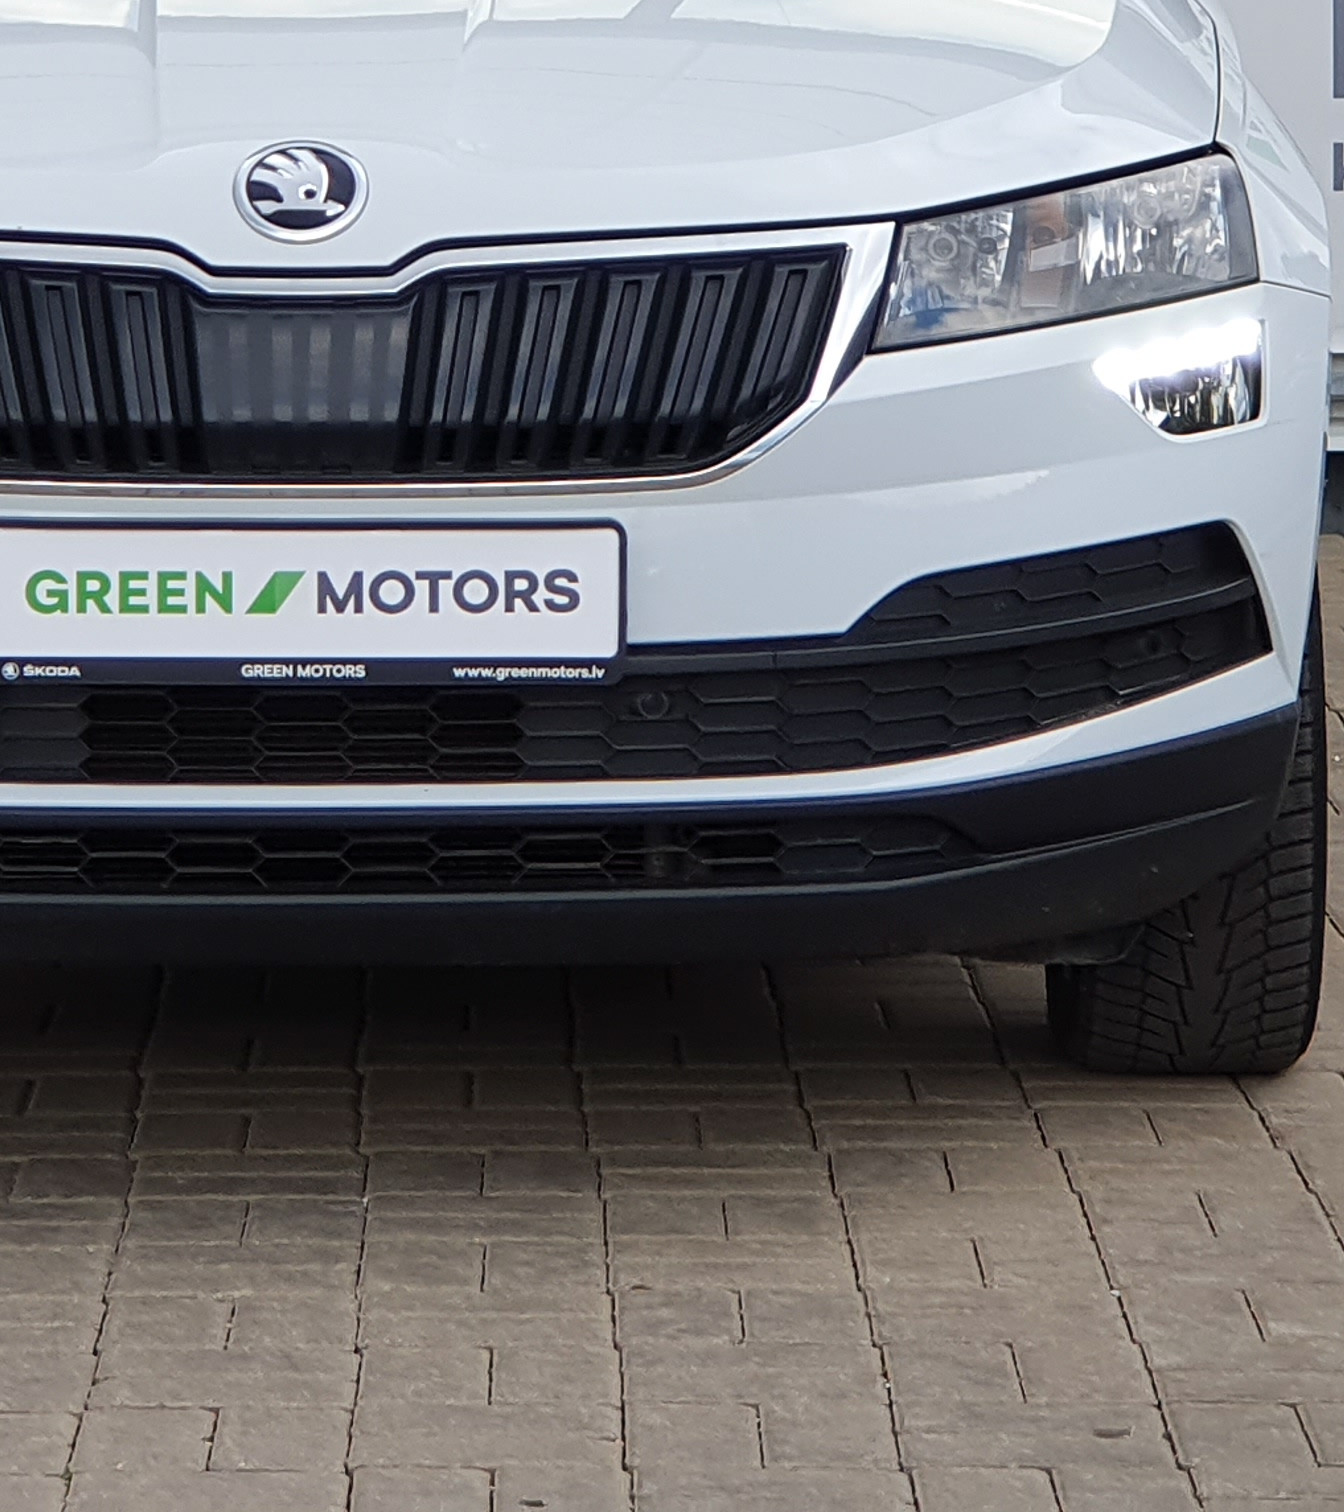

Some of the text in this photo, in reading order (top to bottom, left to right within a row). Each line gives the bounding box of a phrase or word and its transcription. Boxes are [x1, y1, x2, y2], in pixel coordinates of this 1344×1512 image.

[25, 569, 580, 615] GREEN MOTORS
[23, 663, 81, 677] ŠKODA
[241, 664, 366, 678] GREEN MOTORS
[453, 664, 605, 681] www.greenmotors.lv
